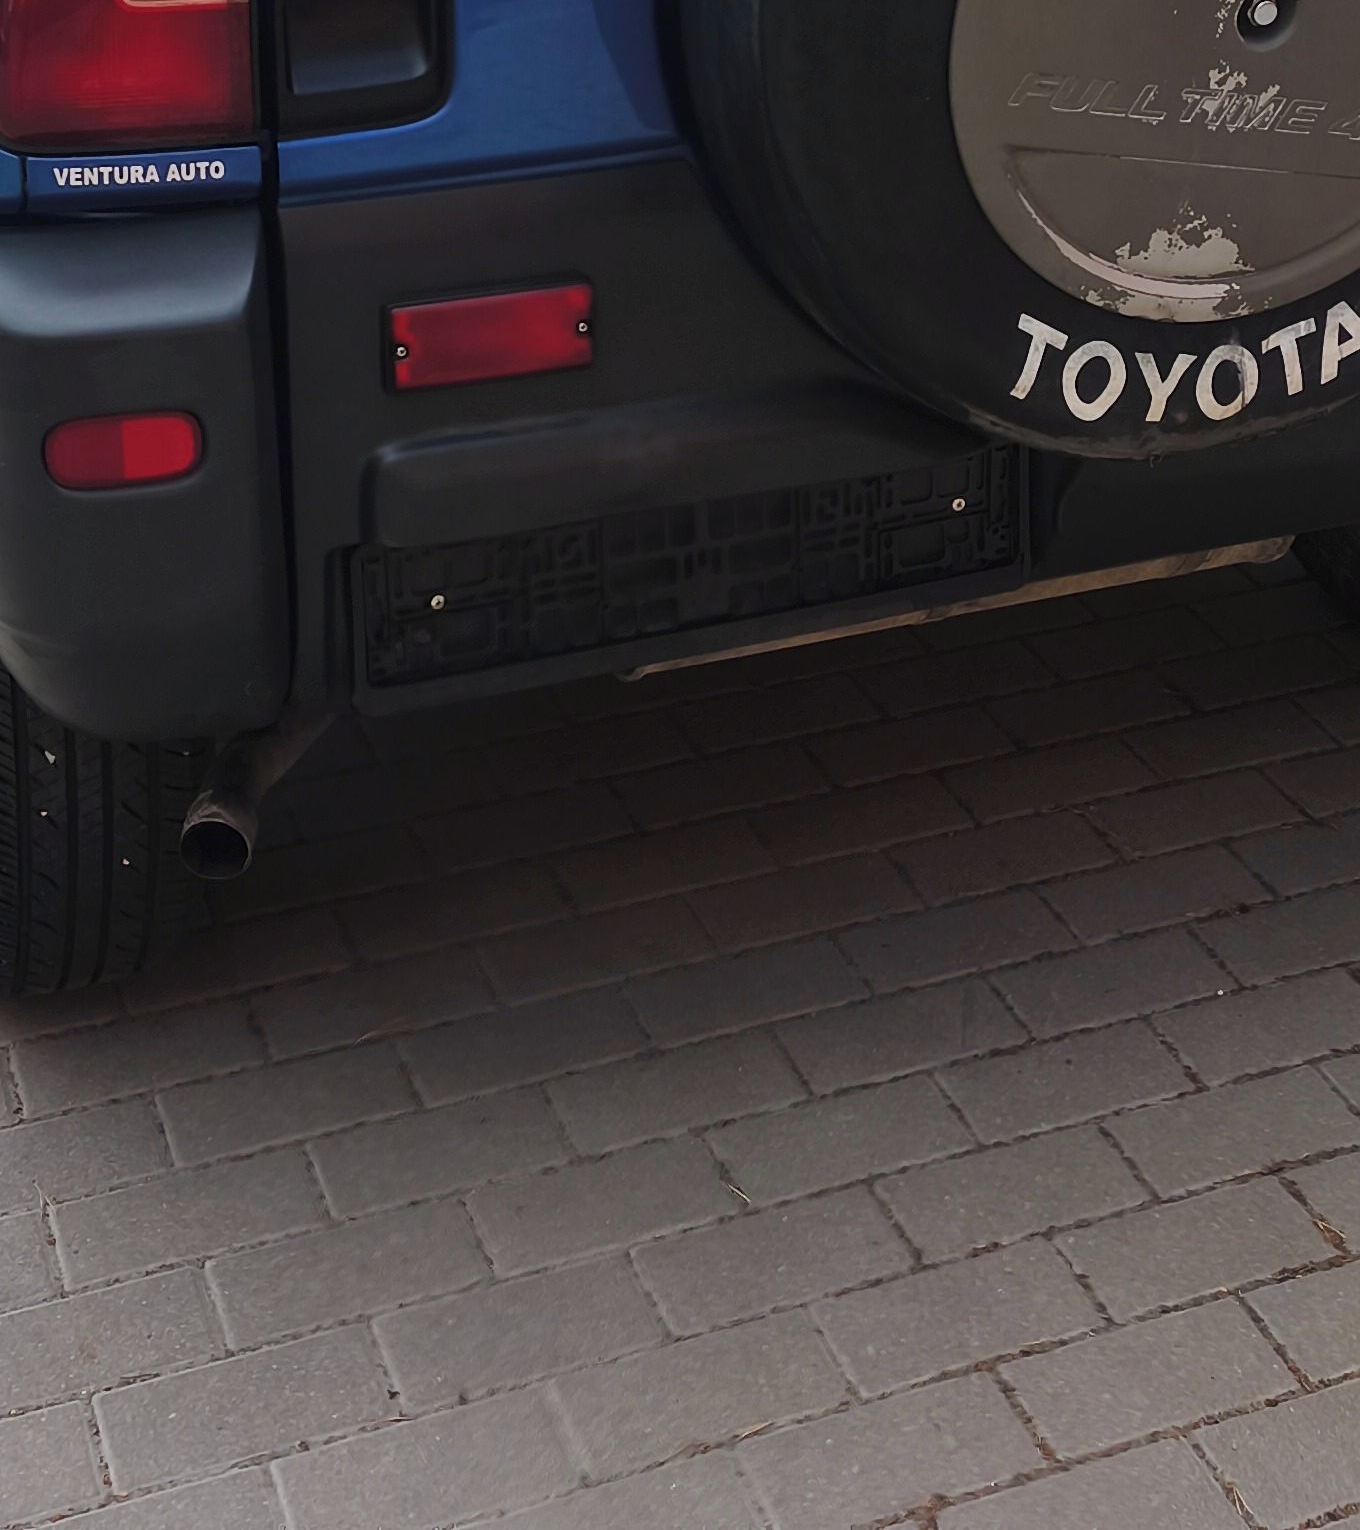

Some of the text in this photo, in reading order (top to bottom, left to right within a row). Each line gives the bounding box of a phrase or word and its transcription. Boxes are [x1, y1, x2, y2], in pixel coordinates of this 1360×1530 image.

[1008, 72, 1168, 123] FULL
[1180, 87, 1328, 136] TIME
[52, 160, 225, 186] VENTURA AUTO
